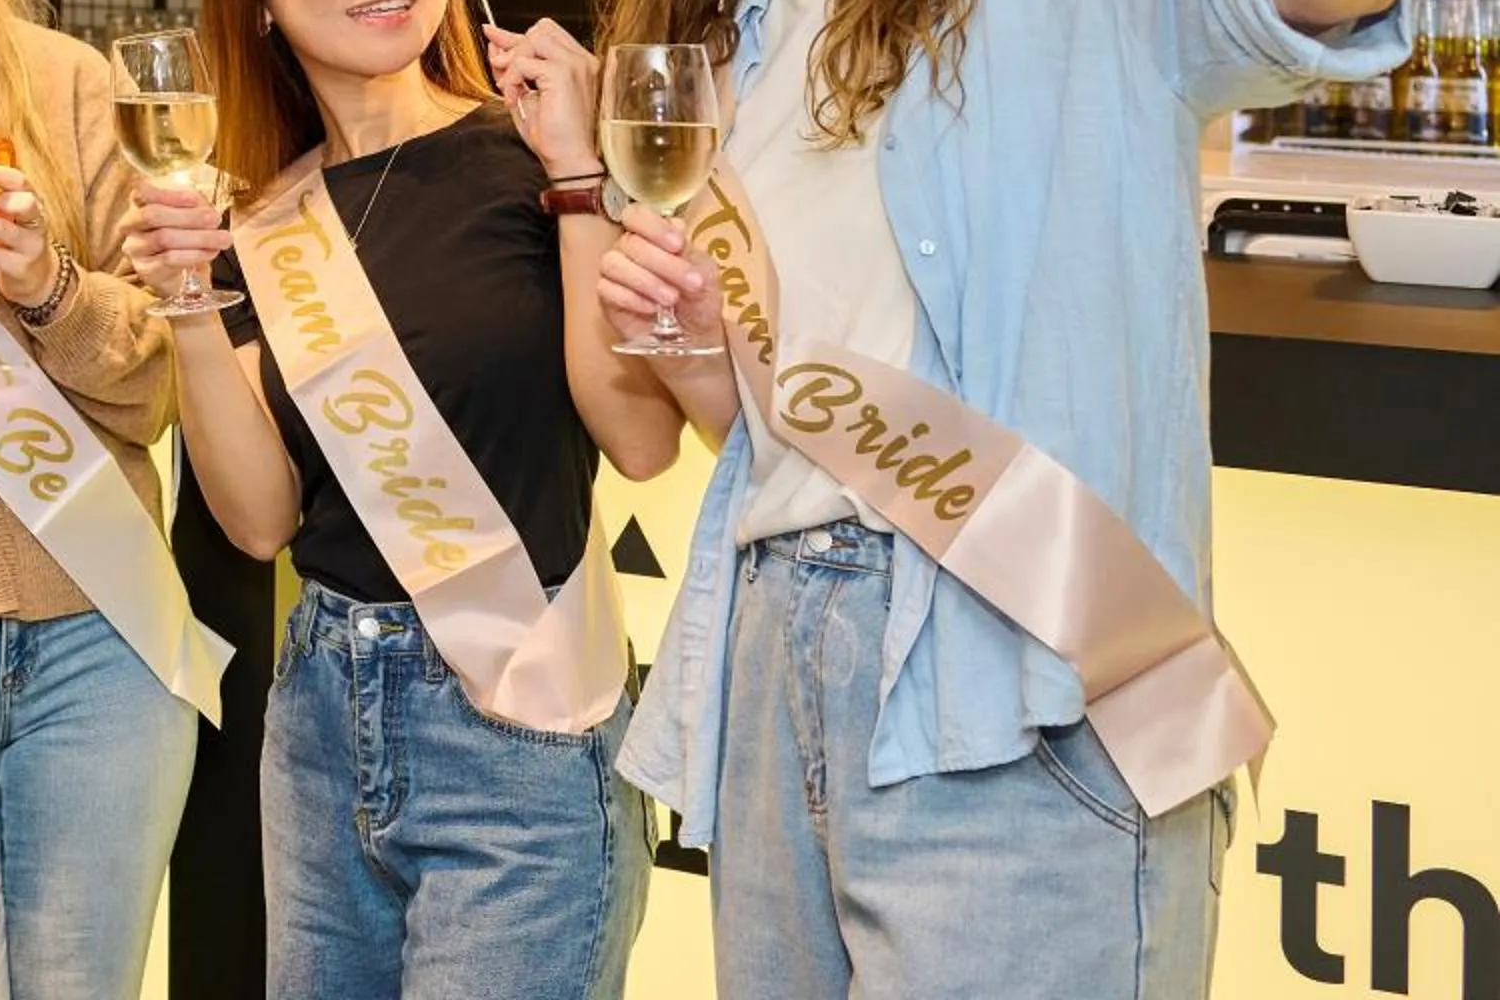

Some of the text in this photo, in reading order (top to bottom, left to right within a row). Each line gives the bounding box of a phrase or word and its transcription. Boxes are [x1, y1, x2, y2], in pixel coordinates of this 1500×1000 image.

[255, 189, 474, 572] Team Bride
[689, 167, 975, 521] Team Bride
[1256, 799, 1500, 1000] th
